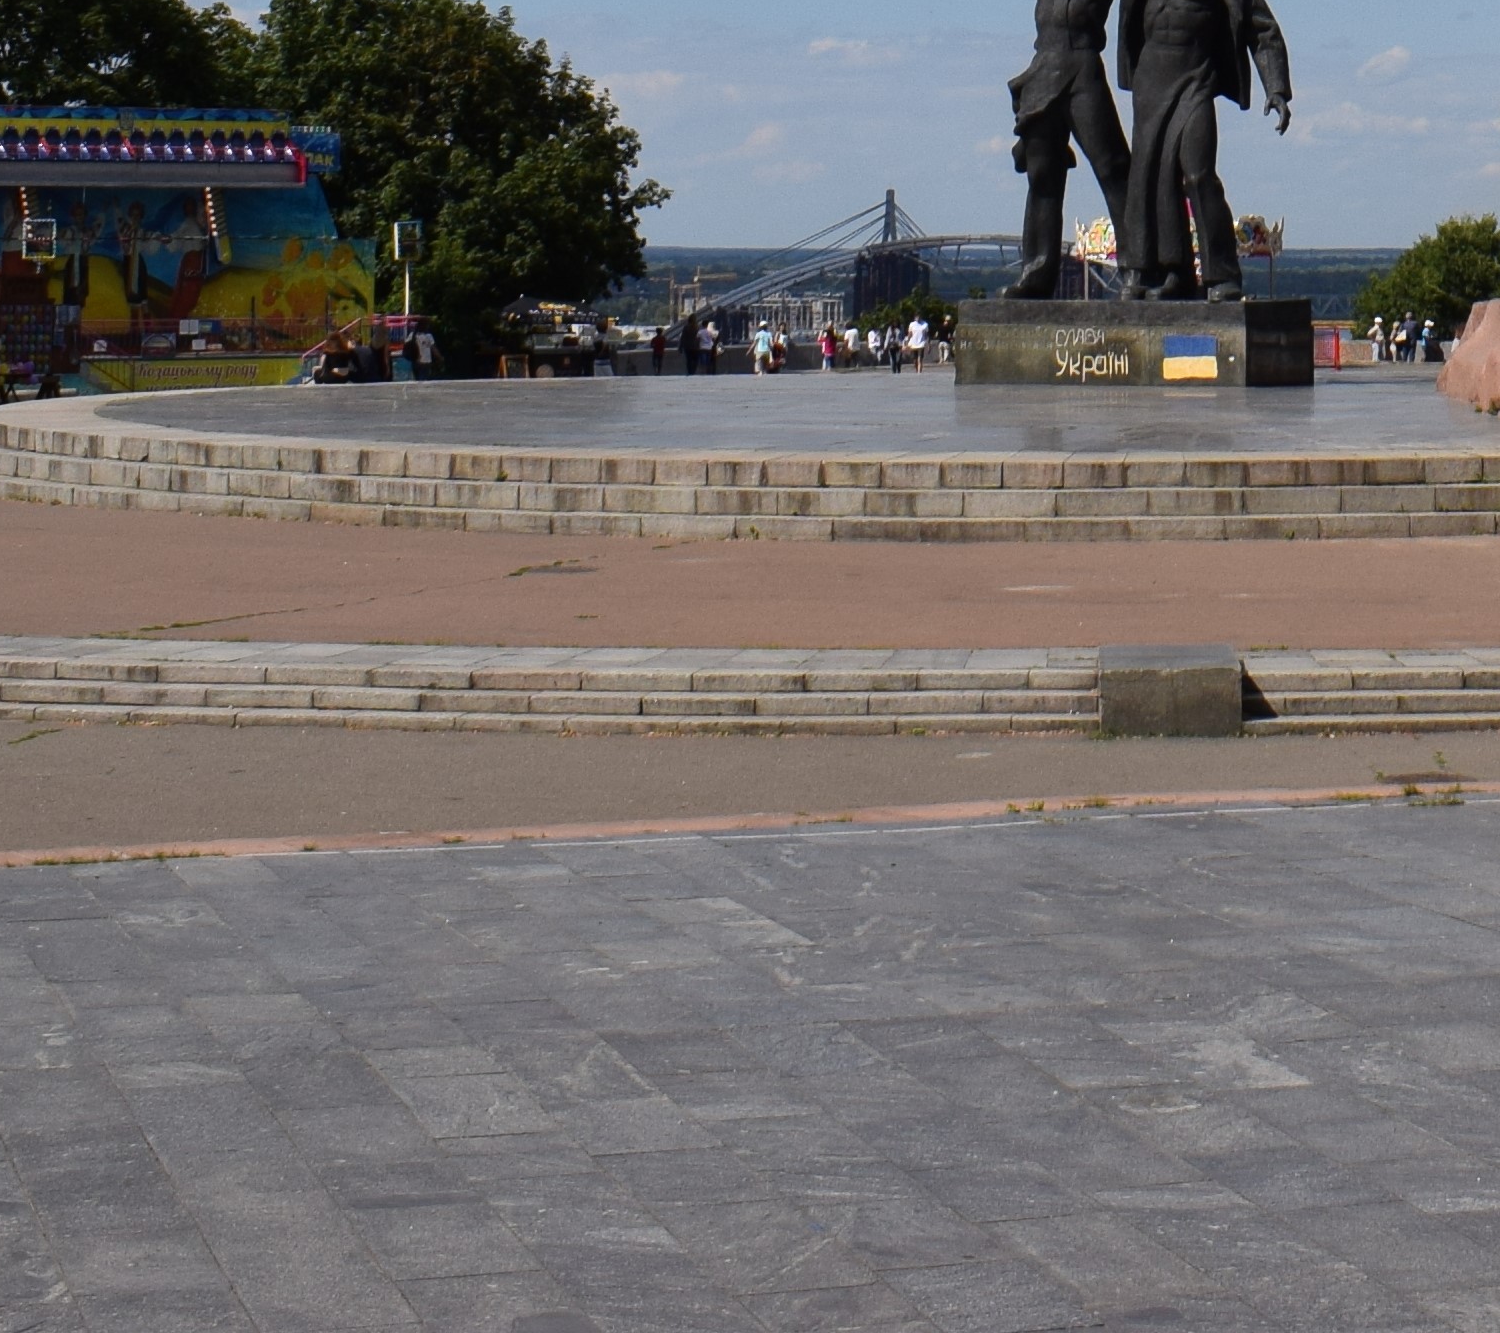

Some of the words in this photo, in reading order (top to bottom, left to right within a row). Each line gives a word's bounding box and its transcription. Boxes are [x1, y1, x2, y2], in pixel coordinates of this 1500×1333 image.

[138, 363, 222, 381] Козацькому
[225, 364, 258, 381] роду
[1055, 347, 1129, 383] Україні
